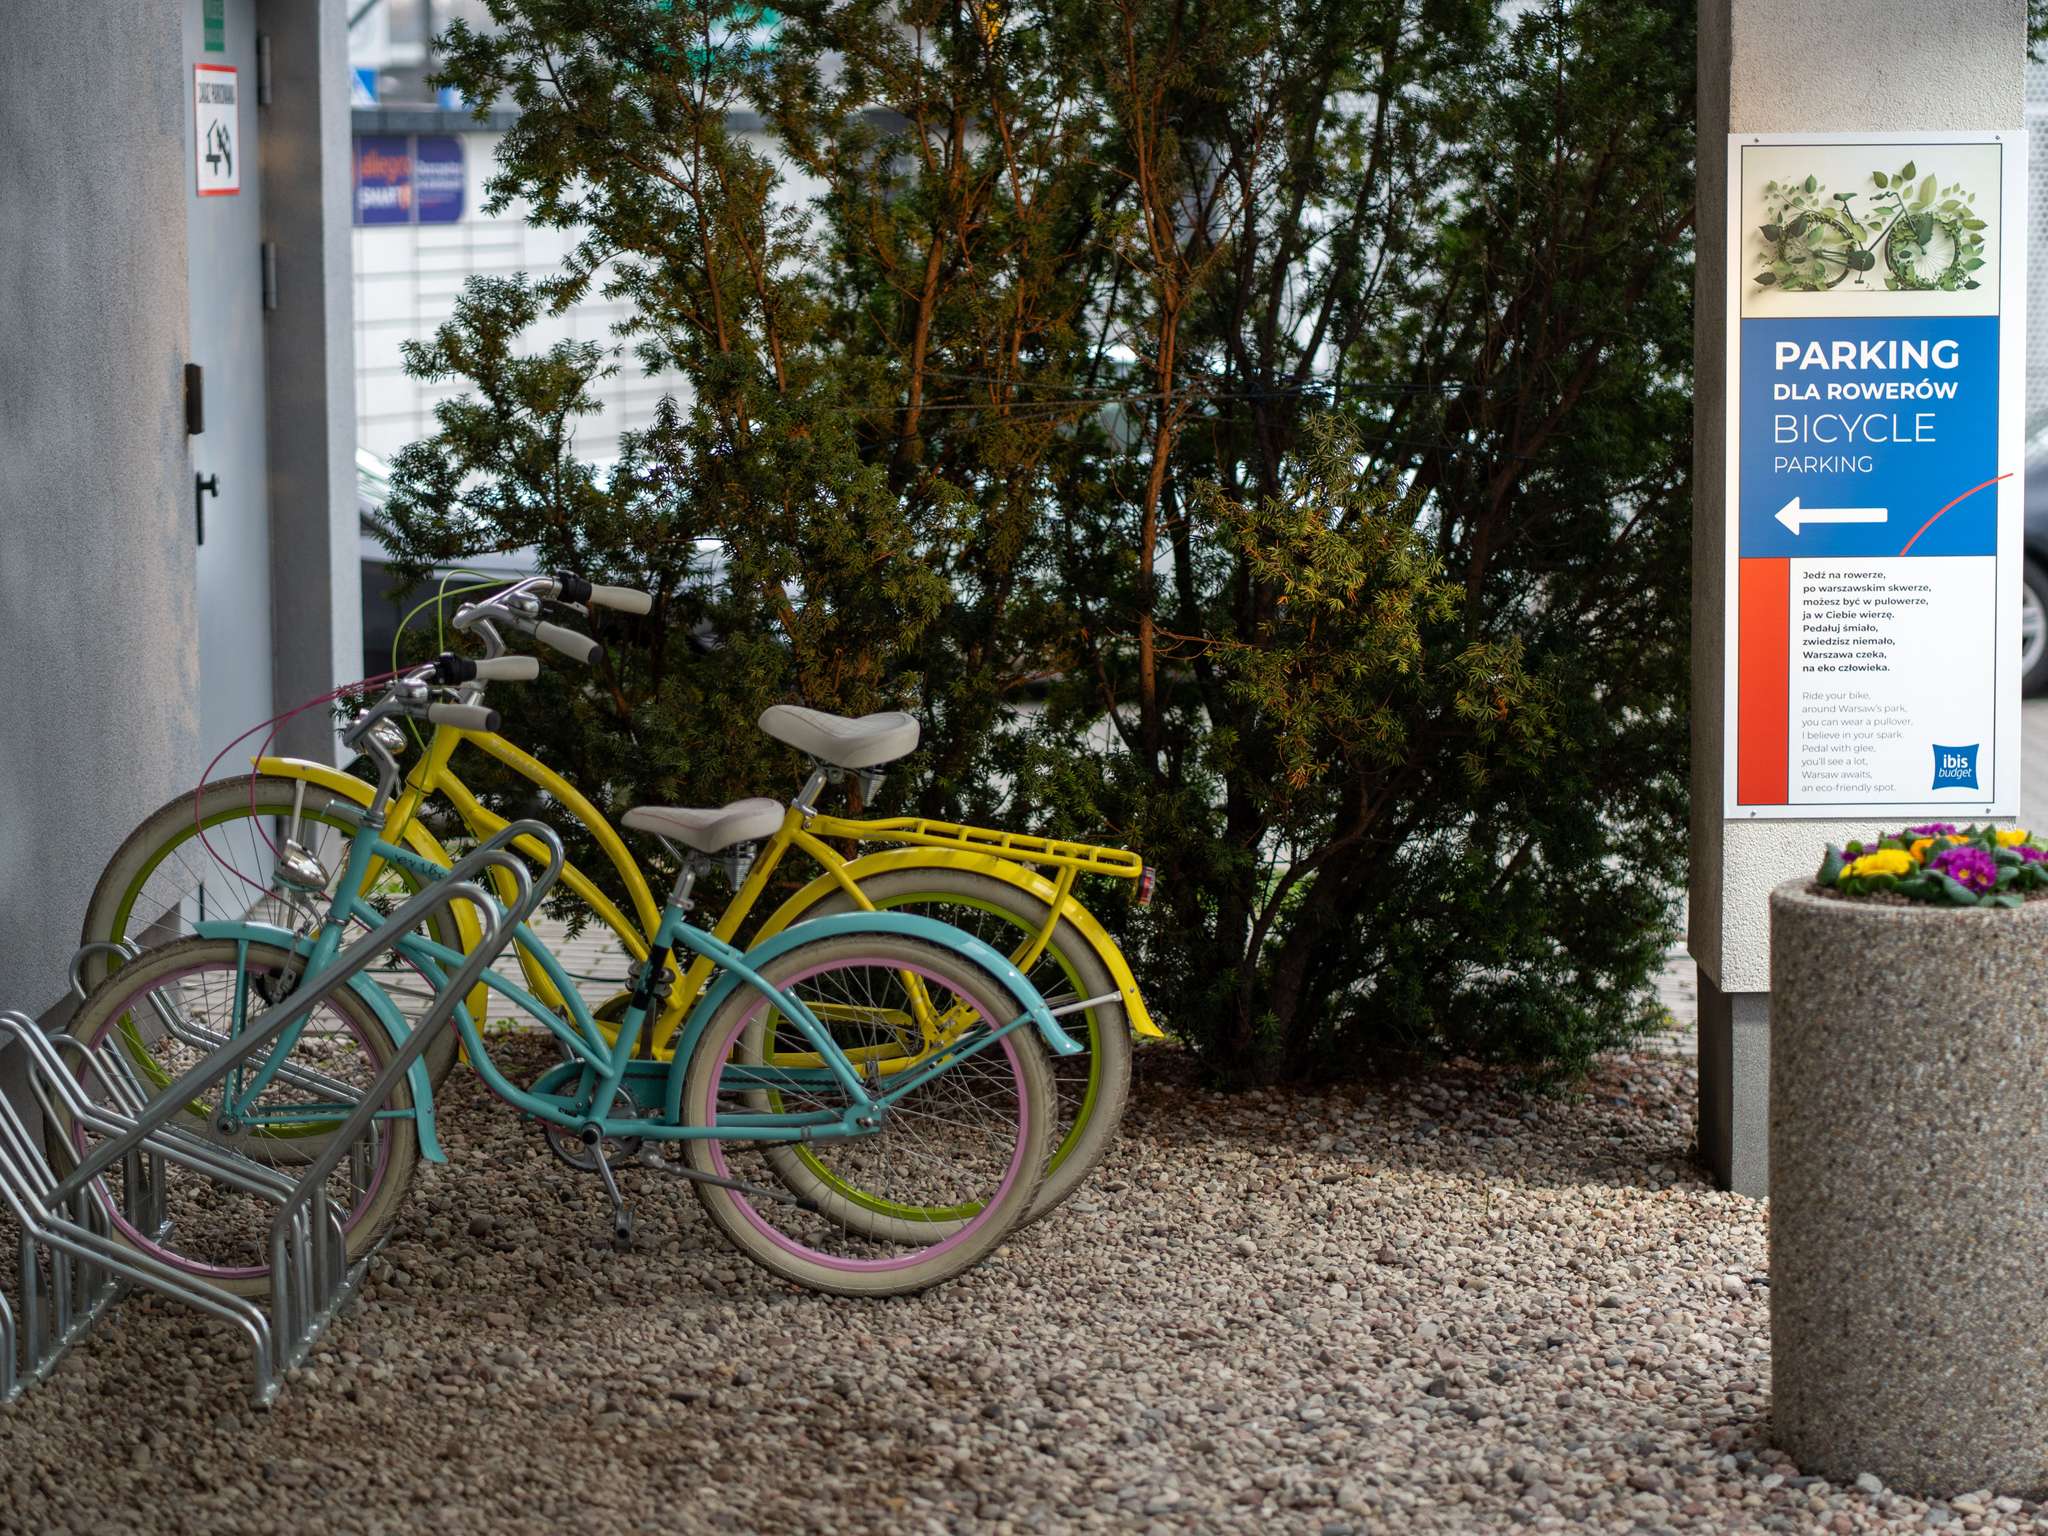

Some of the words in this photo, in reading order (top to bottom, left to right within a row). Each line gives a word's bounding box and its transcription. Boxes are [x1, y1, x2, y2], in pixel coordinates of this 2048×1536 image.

[1776, 340, 1958, 370] PARKING
[1774, 384, 1821, 400] DLA
[1828, 379, 1958, 400] ROWERÓW
[1774, 413, 1936, 444] BICYCLE
[1775, 456, 1872, 473] PARKING
[1803, 571, 1826, 580] Jedź
[1829, 572, 1841, 580] na
[1844, 572, 1886, 580] rowerze,
[1804, 586, 1817, 595] po
[1819, 584, 1886, 593] warszawskim
[1888, 584, 1932, 593] skwerze,
[1804, 597, 1841, 606] możesz
[1843, 598, 1861, 608] być
[1802, 611, 1812, 622] ja
[1826, 611, 1857, 620] Ciebie
[1860, 611, 1895, 621] wierzę.
[1803, 624, 1841, 634] Pedałuj
[1843, 624, 1879, 633] śmiało,
[1803, 637, 1850, 646] zwiedzisz
[1853, 637, 1896, 646] niemało,
[1803, 651, 1854, 659] Warszawa
[1856, 651, 1887, 660] czeka,
[1803, 665, 1815, 673] na
[1818, 664, 1836, 673] eko
[1838, 663, 1890, 672] człowieka.
[1803, 692, 1824, 701] Ride
[1825, 693, 1846, 702] your
[1802, 704, 1836, 713] around
[1839, 704, 1883, 713] Warsaw's
[1802, 720, 1820, 729] you
[1821, 719, 1839, 727] can
[1866, 718, 1872, 727] a
[1808, 731, 1841, 740] believe
[1842, 731, 1852, 740] in
[1854, 732, 1874, 741] your
[1802, 744, 1829, 753] Pedal
[1831, 744, 1852, 753] with
[1801, 758, 1826, 768] you'll
[1828, 758, 1844, 766] see
[1846, 758, 1852, 766] a
[1944, 754, 1968, 768] ibis
[1802, 770, 1840, 780] Warsaw
[1939, 768, 1972, 779] budget
[1802, 785, 1814, 793] an
[1816, 784, 1872, 793] eco-friendly
[1874, 784, 1897, 793] spot.
